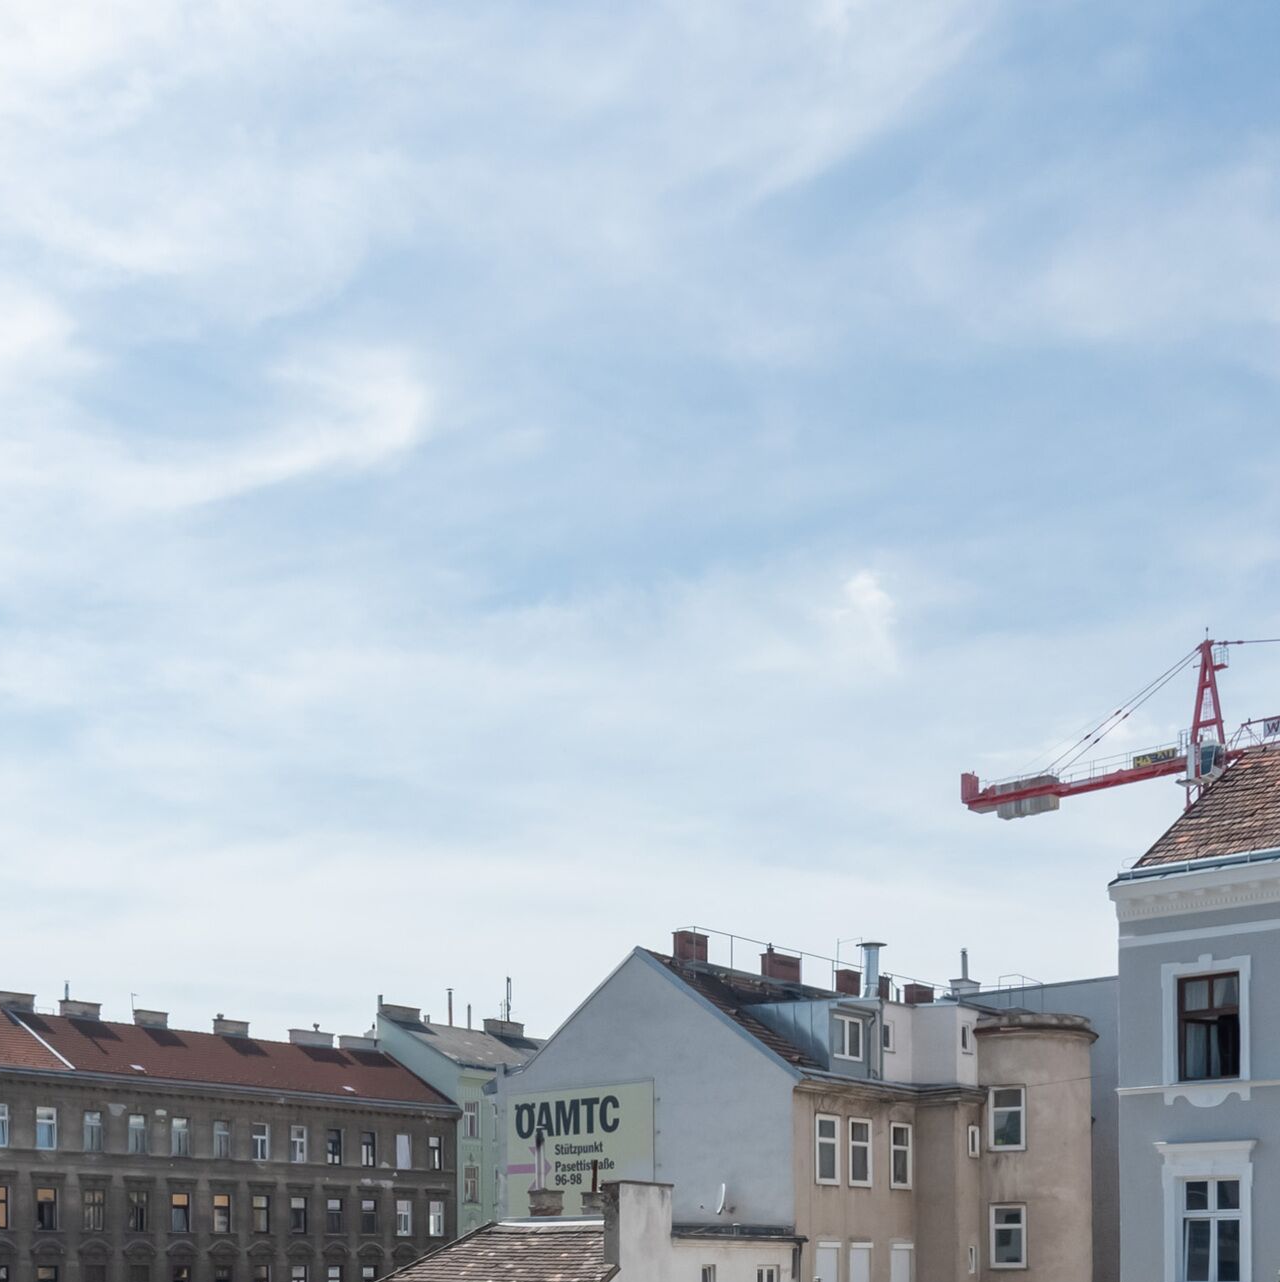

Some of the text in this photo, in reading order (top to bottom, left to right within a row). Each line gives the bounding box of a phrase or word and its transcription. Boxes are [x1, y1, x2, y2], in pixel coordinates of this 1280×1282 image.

[515, 1095, 620, 1139] ÖAMTC
[555, 1141, 603, 1156] Stützpunkt
[555, 1158, 615, 1172] Pasettistaße
[555, 1173, 582, 1186] 96-98
